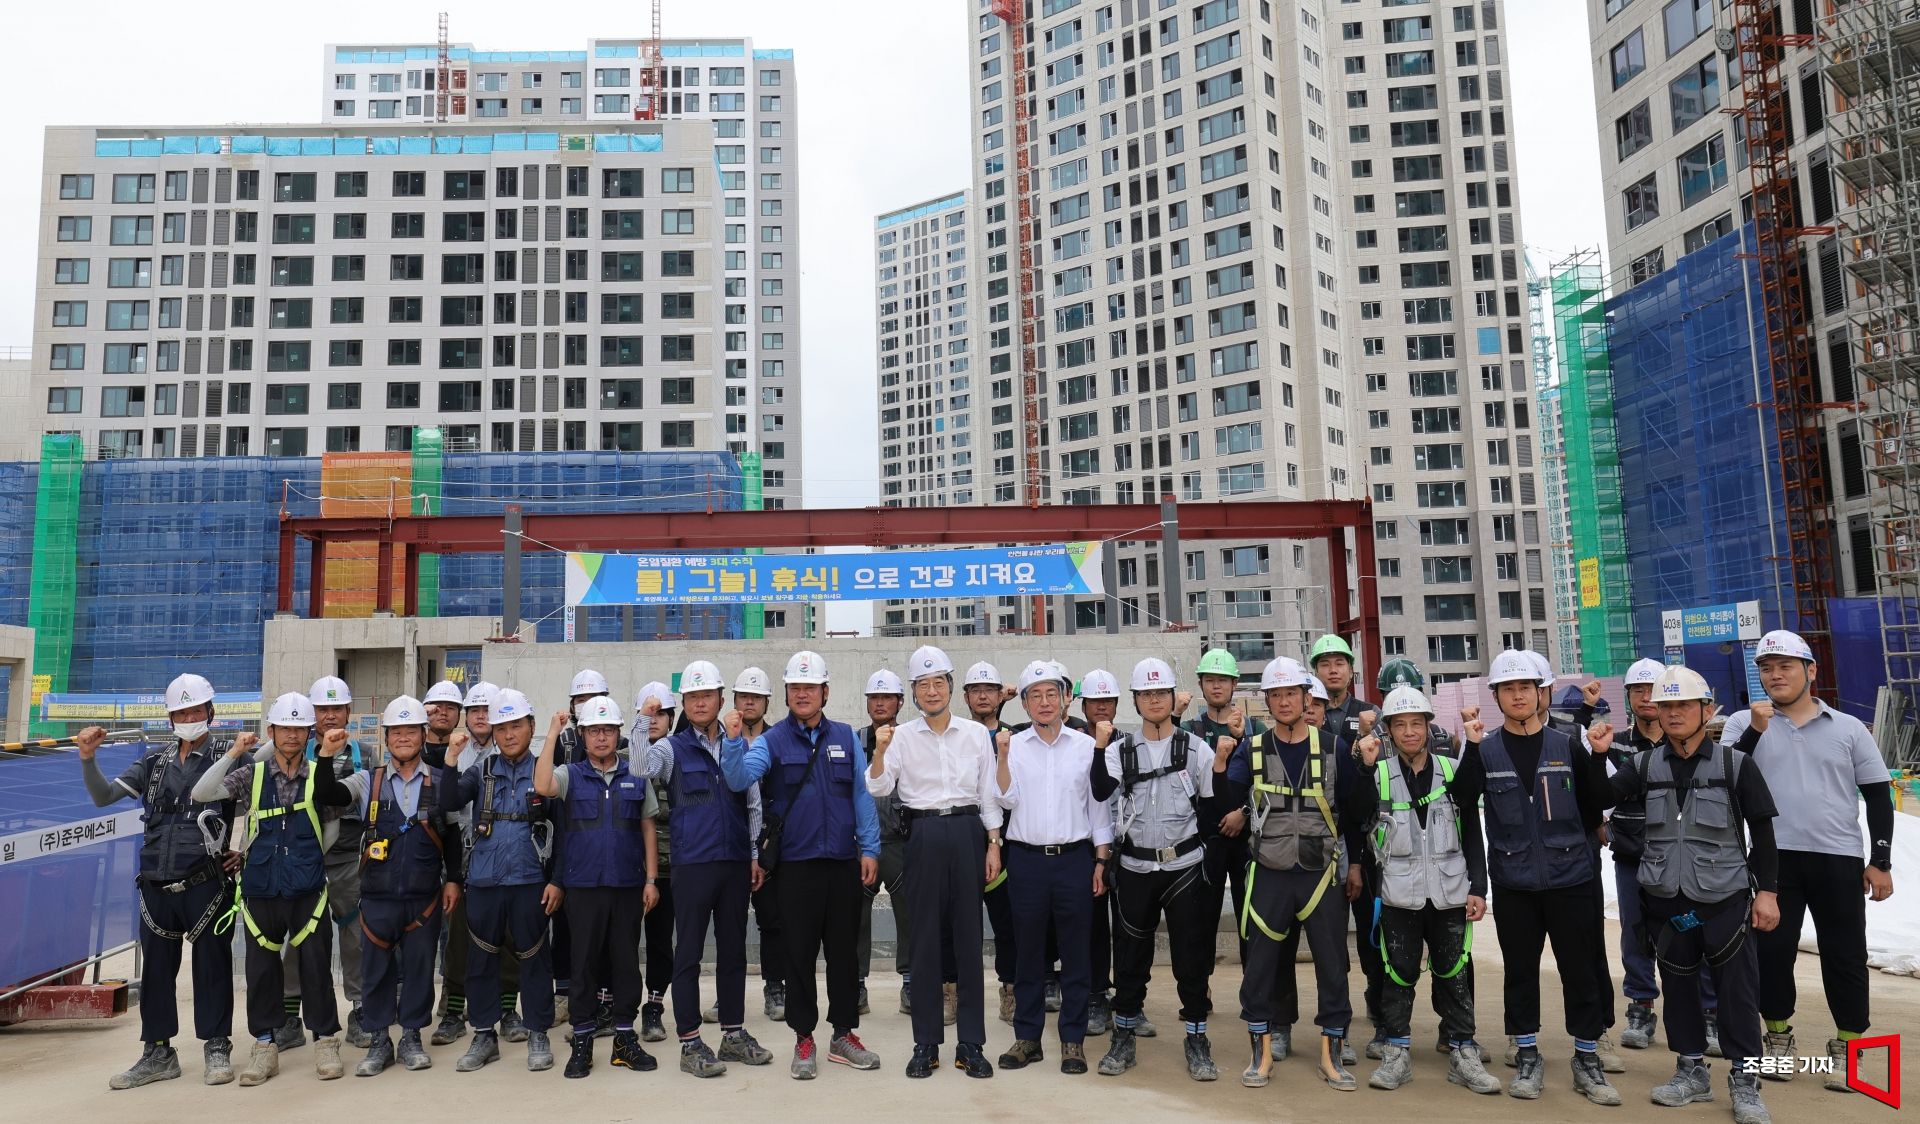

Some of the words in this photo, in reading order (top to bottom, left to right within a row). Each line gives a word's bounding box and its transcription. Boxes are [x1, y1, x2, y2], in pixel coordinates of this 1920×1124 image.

[637, 557, 682, 567] 온열질환
[685, 557, 707, 567] 예방
[710, 557, 728, 567] 3대
[731, 556, 752, 566] 수칙
[636, 569, 675, 594] 물!
[689, 568, 757, 593] 그늘!
[771, 566, 839, 592] 휴식!
[854, 566, 900, 590] 으로
[910, 565, 956, 588] 건강
[966, 562, 1036, 586] 지켜요
[1663, 618, 1681, 629] 403동
[1684, 613, 1708, 625] 위험요소
[1739, 614, 1758, 627] 3호기
[1713, 624, 1733, 635] 만들자
[4, 841, 15, 861] 일
[39, 818, 116, 853] (주)준우에스피
